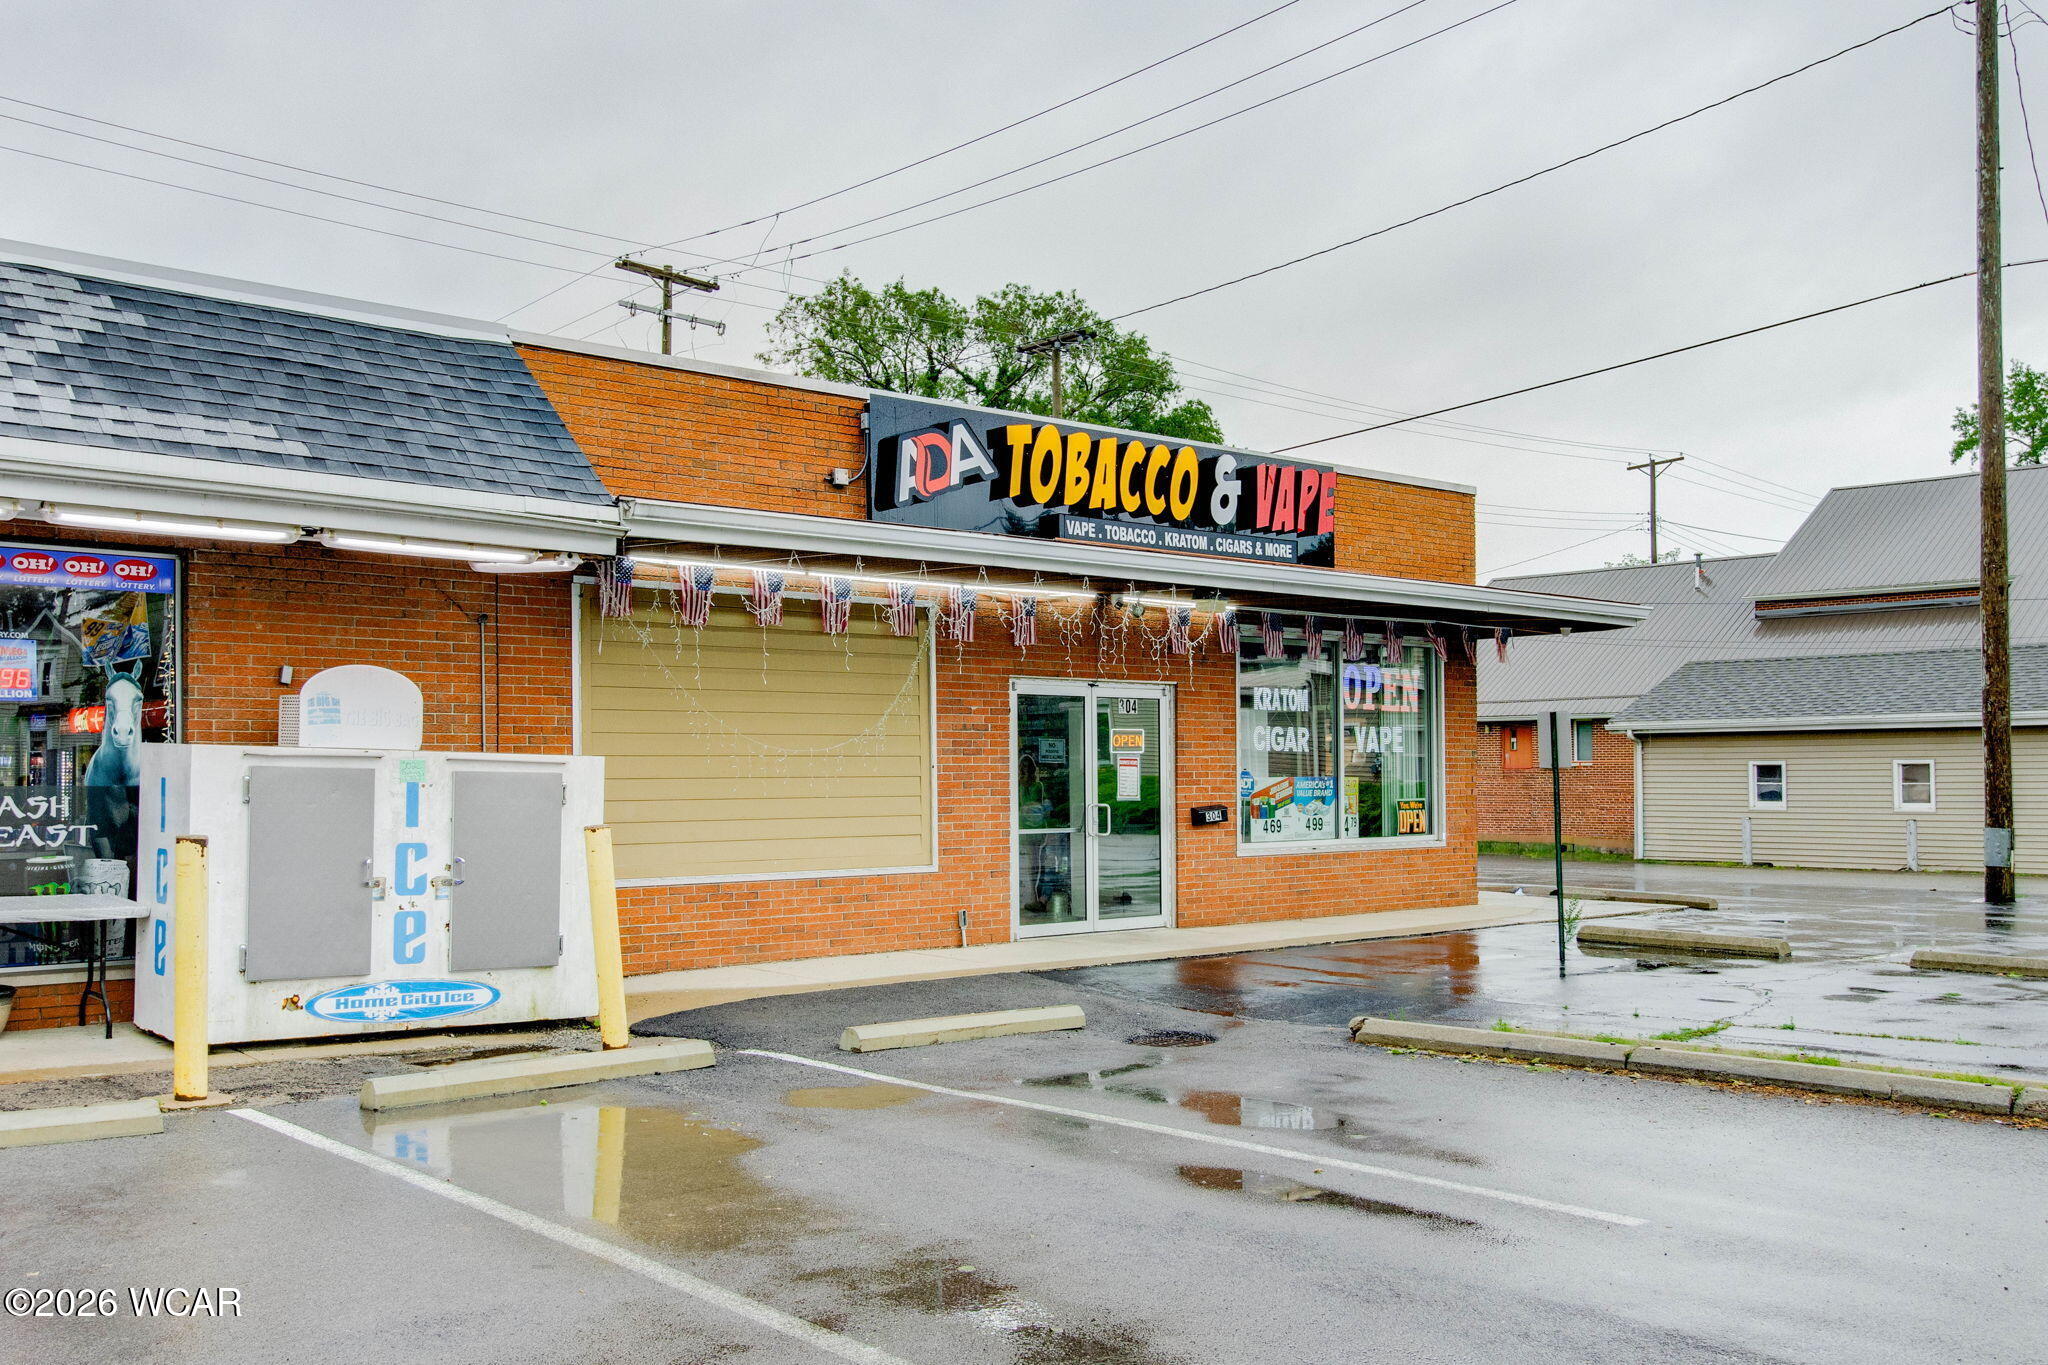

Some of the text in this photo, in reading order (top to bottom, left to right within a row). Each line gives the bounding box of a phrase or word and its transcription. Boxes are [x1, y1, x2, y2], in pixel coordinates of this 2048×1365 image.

[899, 423, 1337, 535] ADA TOBACCO & VAPE
[1066, 520, 1293, 558] VAPE TOBACCO KRATOM CIGARS & MORE
[13, 557, 55, 571] OH!
[65, 560, 105, 574] OH!
[114, 564, 154, 578] OH!
[1253, 687, 1309, 712] KRATOM
[1343, 664, 1420, 713] OPEN
[1112, 734, 1143, 748] OPEN
[1253, 726, 1310, 752] CIGAR
[1354, 726, 1404, 752] VAPE
[335, 991, 474, 1010] Home City Ice
